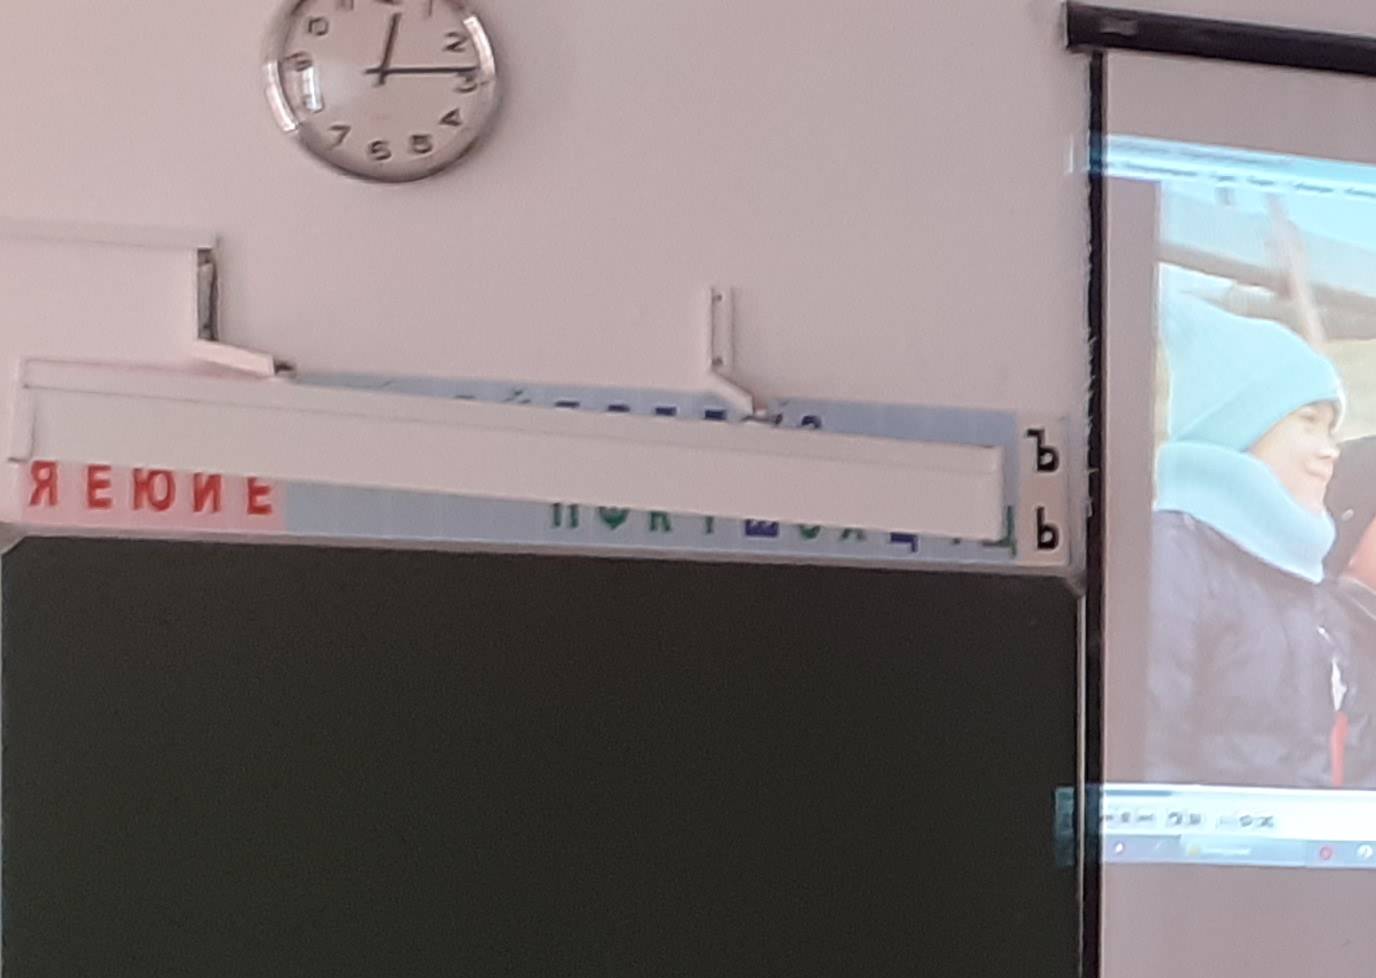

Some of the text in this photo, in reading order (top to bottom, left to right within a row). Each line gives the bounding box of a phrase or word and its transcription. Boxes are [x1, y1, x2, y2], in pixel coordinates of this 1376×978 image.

[442, 31, 468, 53] 2
[438, 108, 462, 127] 4
[328, 125, 351, 147] 7
[409, 134, 432, 155] 5
[368, 140, 393, 161] 6
[1026, 428, 1060, 472] Ъ
[29, 459, 59, 506] Я
[132, 467, 176, 512] Ю
[1036, 506, 1060, 550] Ь
